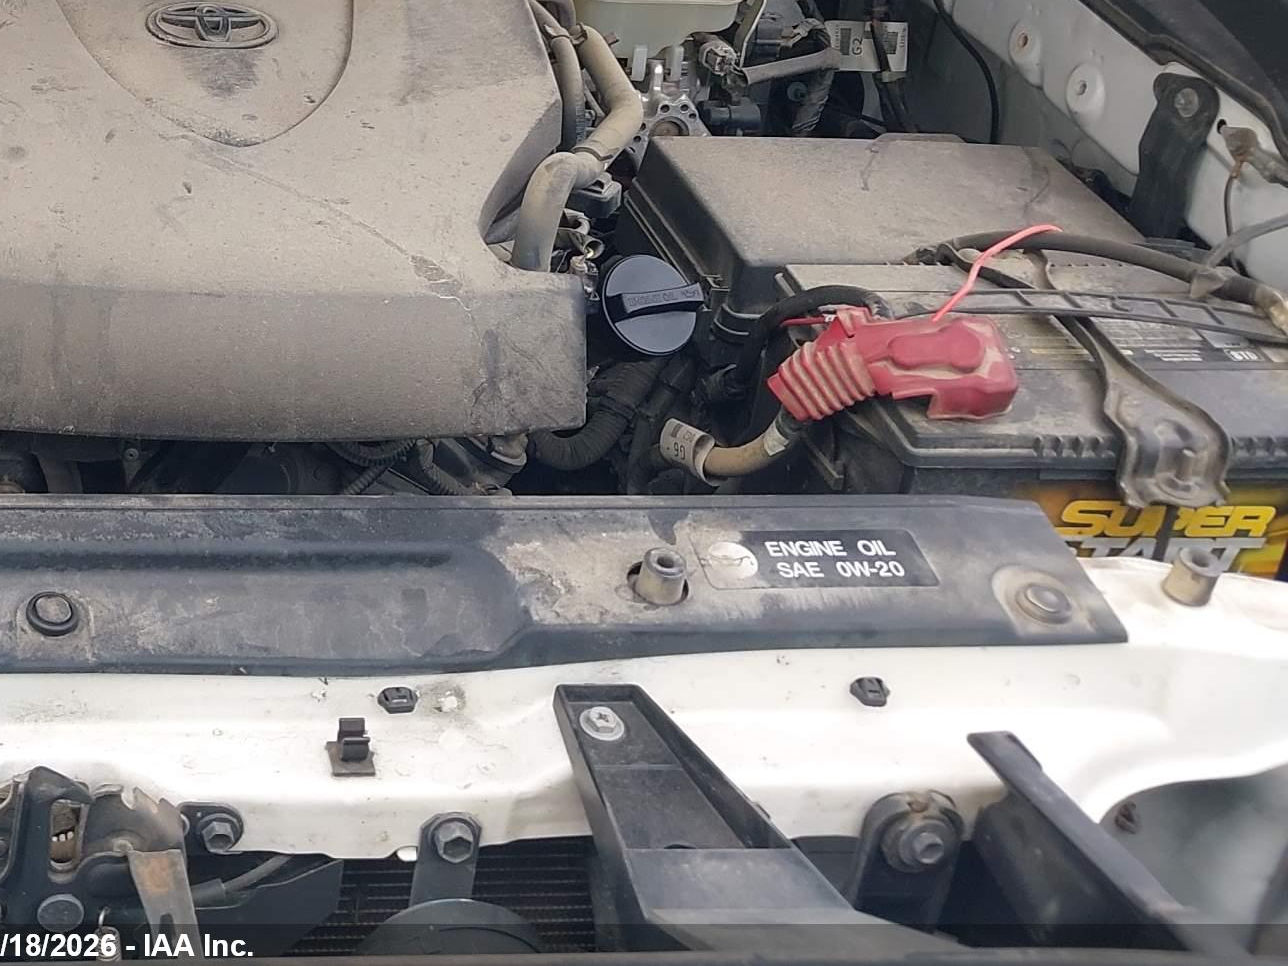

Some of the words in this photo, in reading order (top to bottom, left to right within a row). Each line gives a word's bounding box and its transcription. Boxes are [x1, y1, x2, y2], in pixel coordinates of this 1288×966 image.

[764, 540, 847, 557] ENGINE
[857, 540, 897, 556] OIL
[777, 561, 824, 578] SAE
[835, 560, 905, 577] 0W-20
